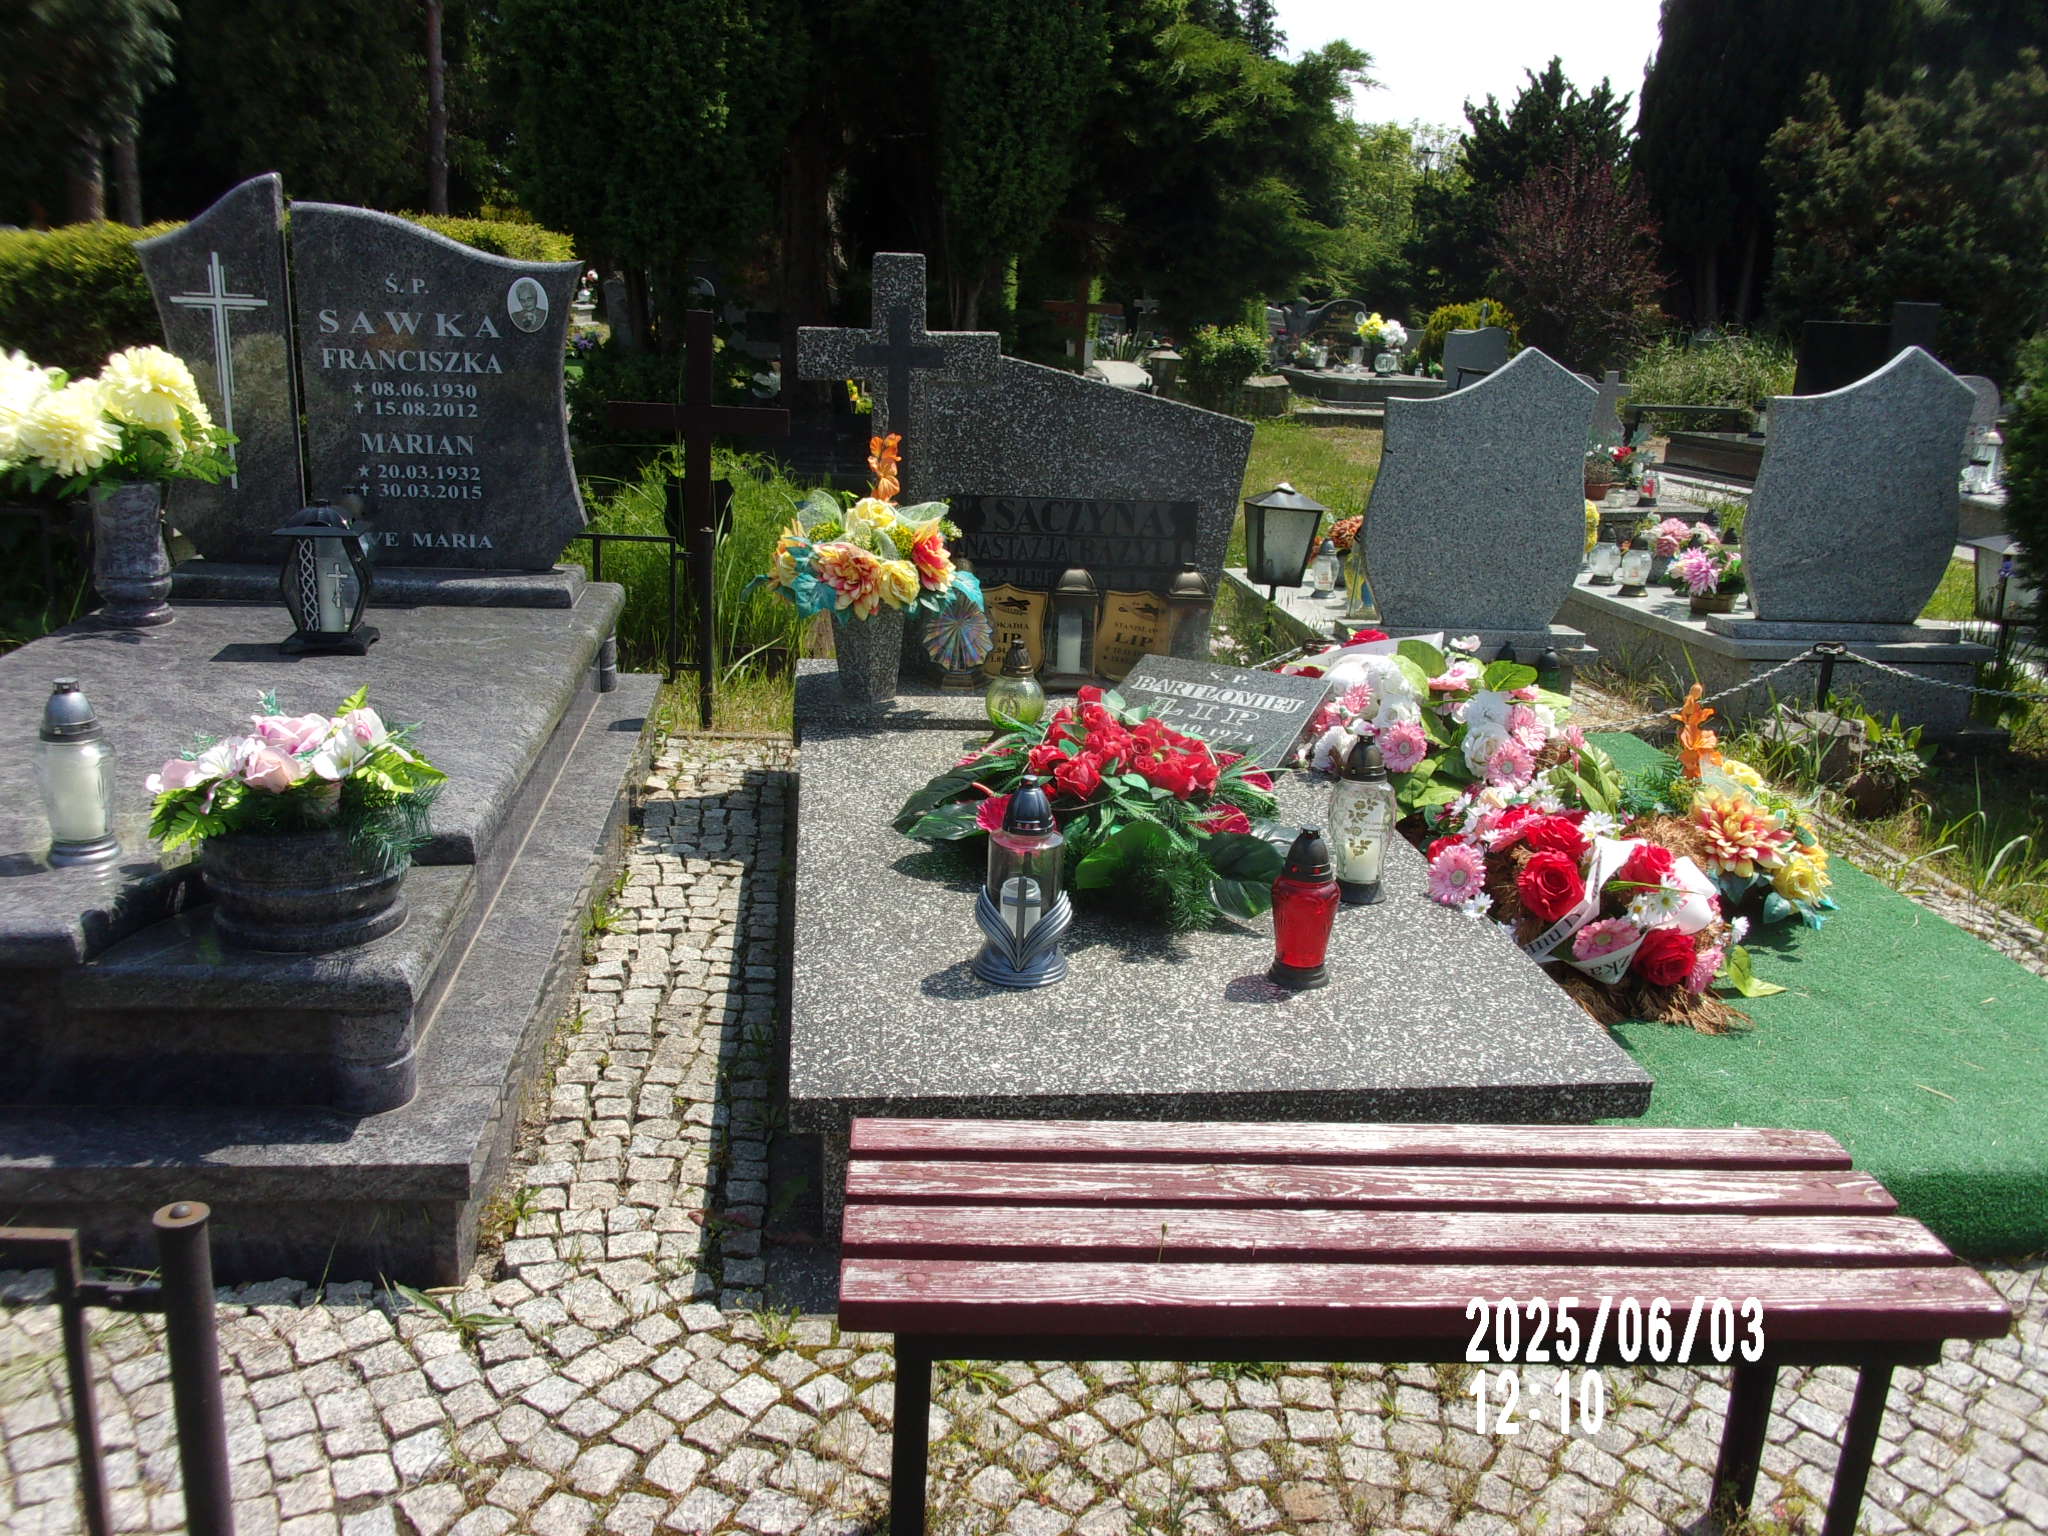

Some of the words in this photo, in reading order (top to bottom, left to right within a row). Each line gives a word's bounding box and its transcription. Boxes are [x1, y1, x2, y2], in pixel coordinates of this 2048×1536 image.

[318, 308, 503, 339] SAWKA
[322, 348, 503, 375] FRANCISZKA
[371, 381, 478, 400] 08.06.1930
[375, 401, 479, 419] 15.08.2012
[360, 432, 475, 456] MARIAN
[377, 464, 481, 482] 20.03.1932
[378, 484, 482, 500] 30.03.2015
[366, 532, 400, 547] VE
[412, 532, 494, 549] MARIA
[1115, 632, 1154, 648] LIP
[1151, 696, 1260, 726] LIP
